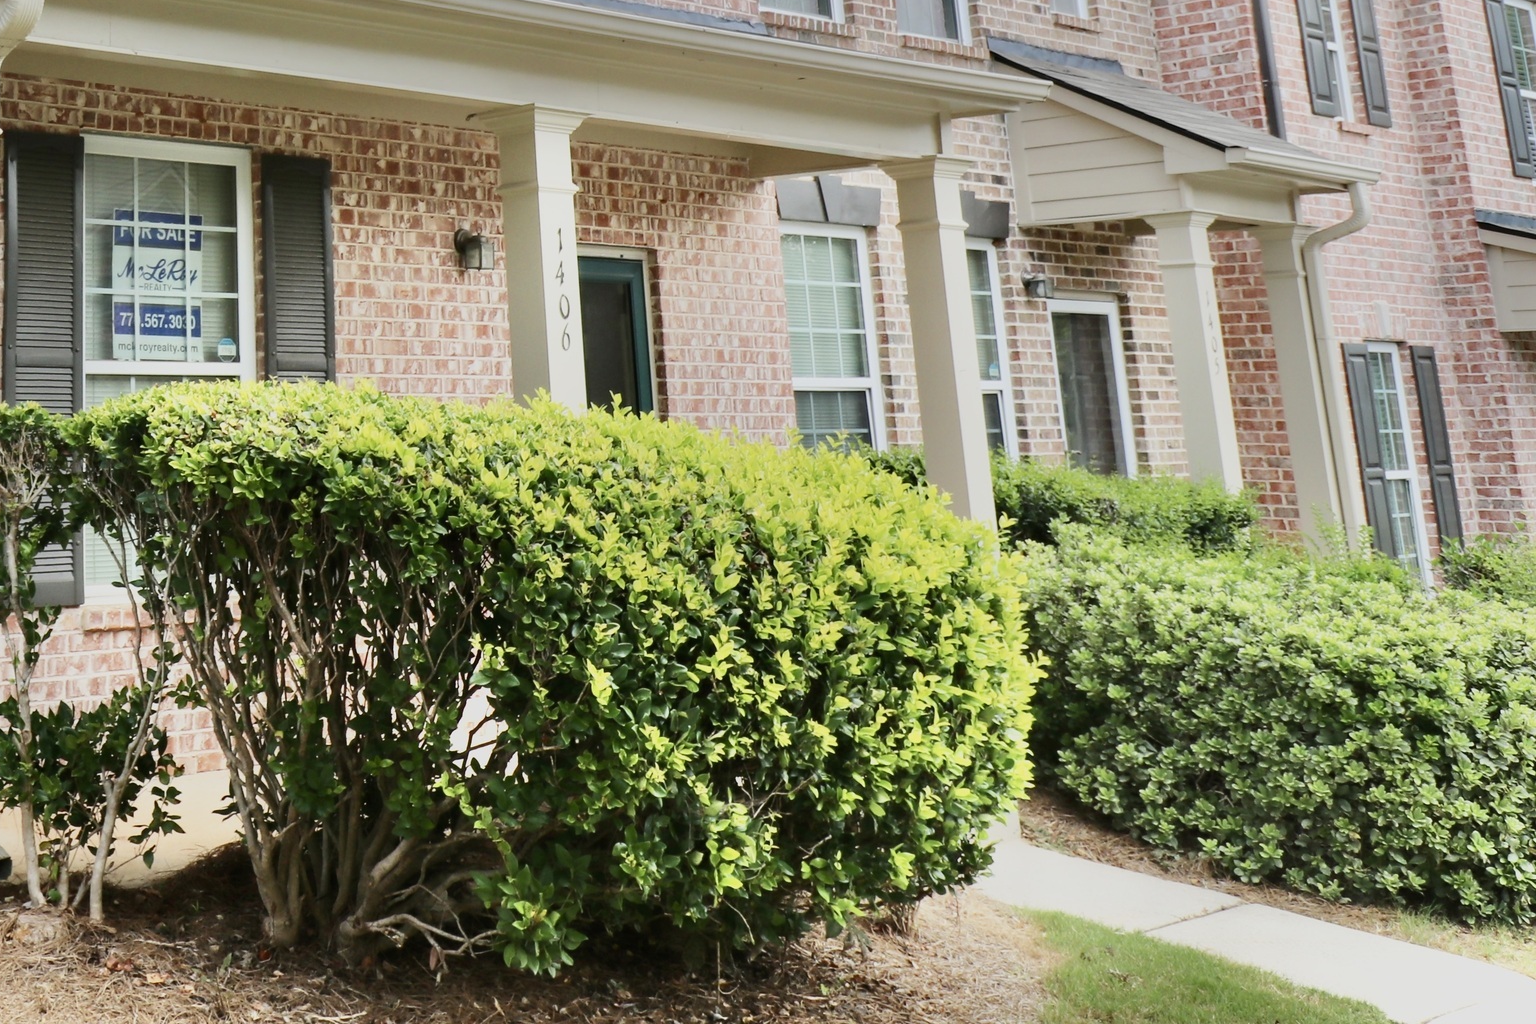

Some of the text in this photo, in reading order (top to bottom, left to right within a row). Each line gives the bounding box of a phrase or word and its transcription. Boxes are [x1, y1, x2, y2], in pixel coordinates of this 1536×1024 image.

[144, 282, 173, 291] REALTY
[555, 227, 571, 352] 1406
[120, 312, 196, 330] 77.567.3030
[118, 342, 198, 354] mclroyrealty.cm
